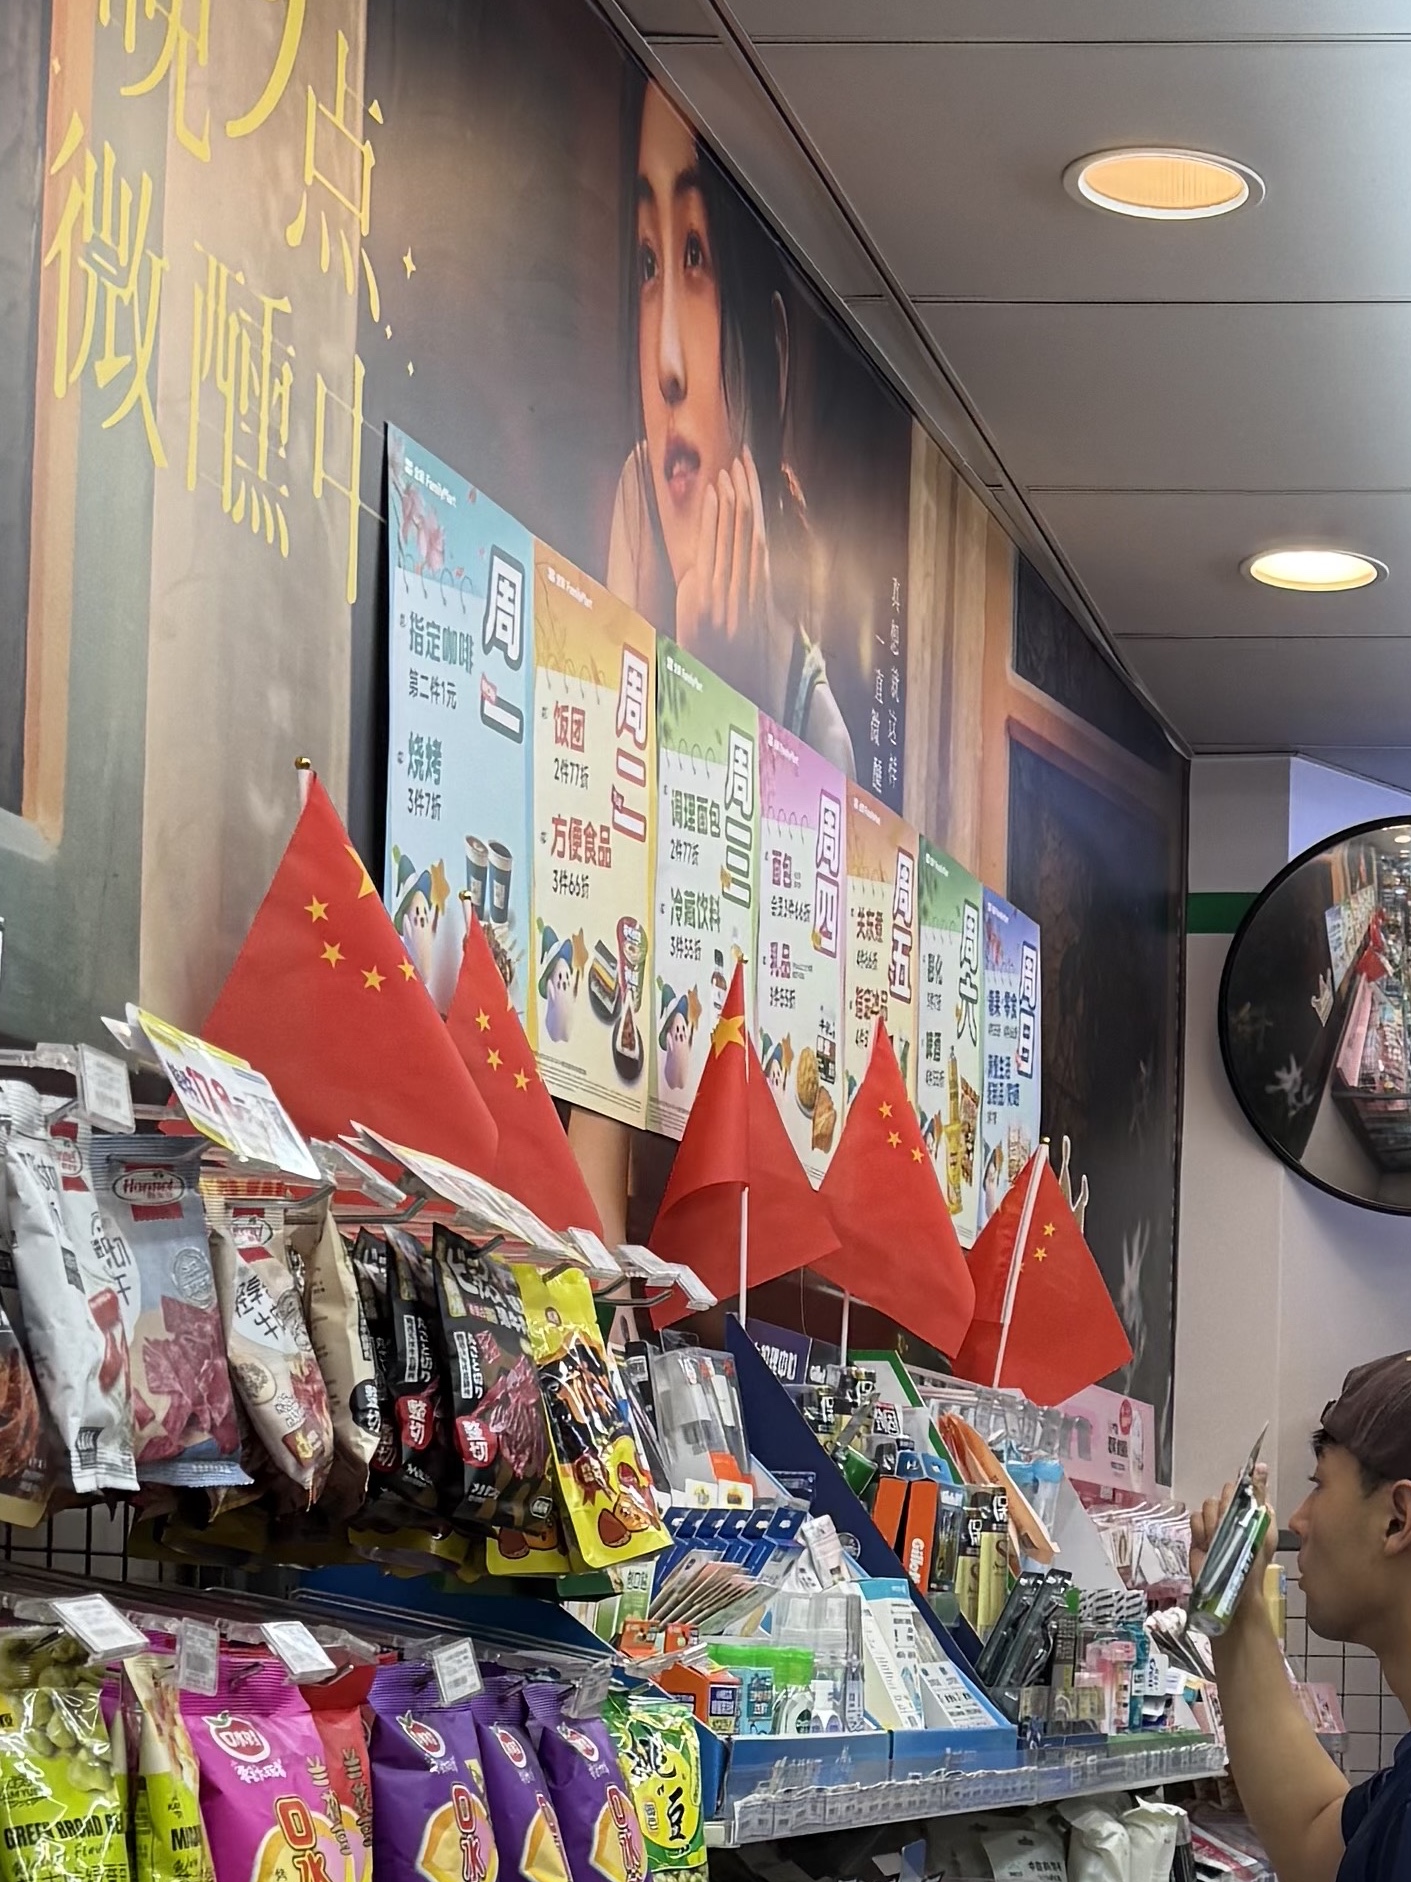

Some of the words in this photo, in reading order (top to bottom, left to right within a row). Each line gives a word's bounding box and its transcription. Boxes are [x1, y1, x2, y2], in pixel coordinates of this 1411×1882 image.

[409, 611, 475, 676] 指定咖啡
[482, 544, 524, 744] 周一
[407, 732, 443, 786] 烧烤
[553, 700, 586, 753] 饭团
[614, 641, 650, 843] 周二
[407, 787, 442, 822] 3件7折
[550, 813, 612, 870] 方便食品
[671, 788, 722, 839] 调理面包
[721, 723, 755, 910] 周三
[814, 787, 842, 959] 周四
[888, 845, 915, 1005] 周五
[955, 897, 980, 1047] 周六
[1017, 940, 1039, 1079] 周日
[4, 1823, 55, 1850] GREEN
[57, 1814, 103, 1840] BROAD
